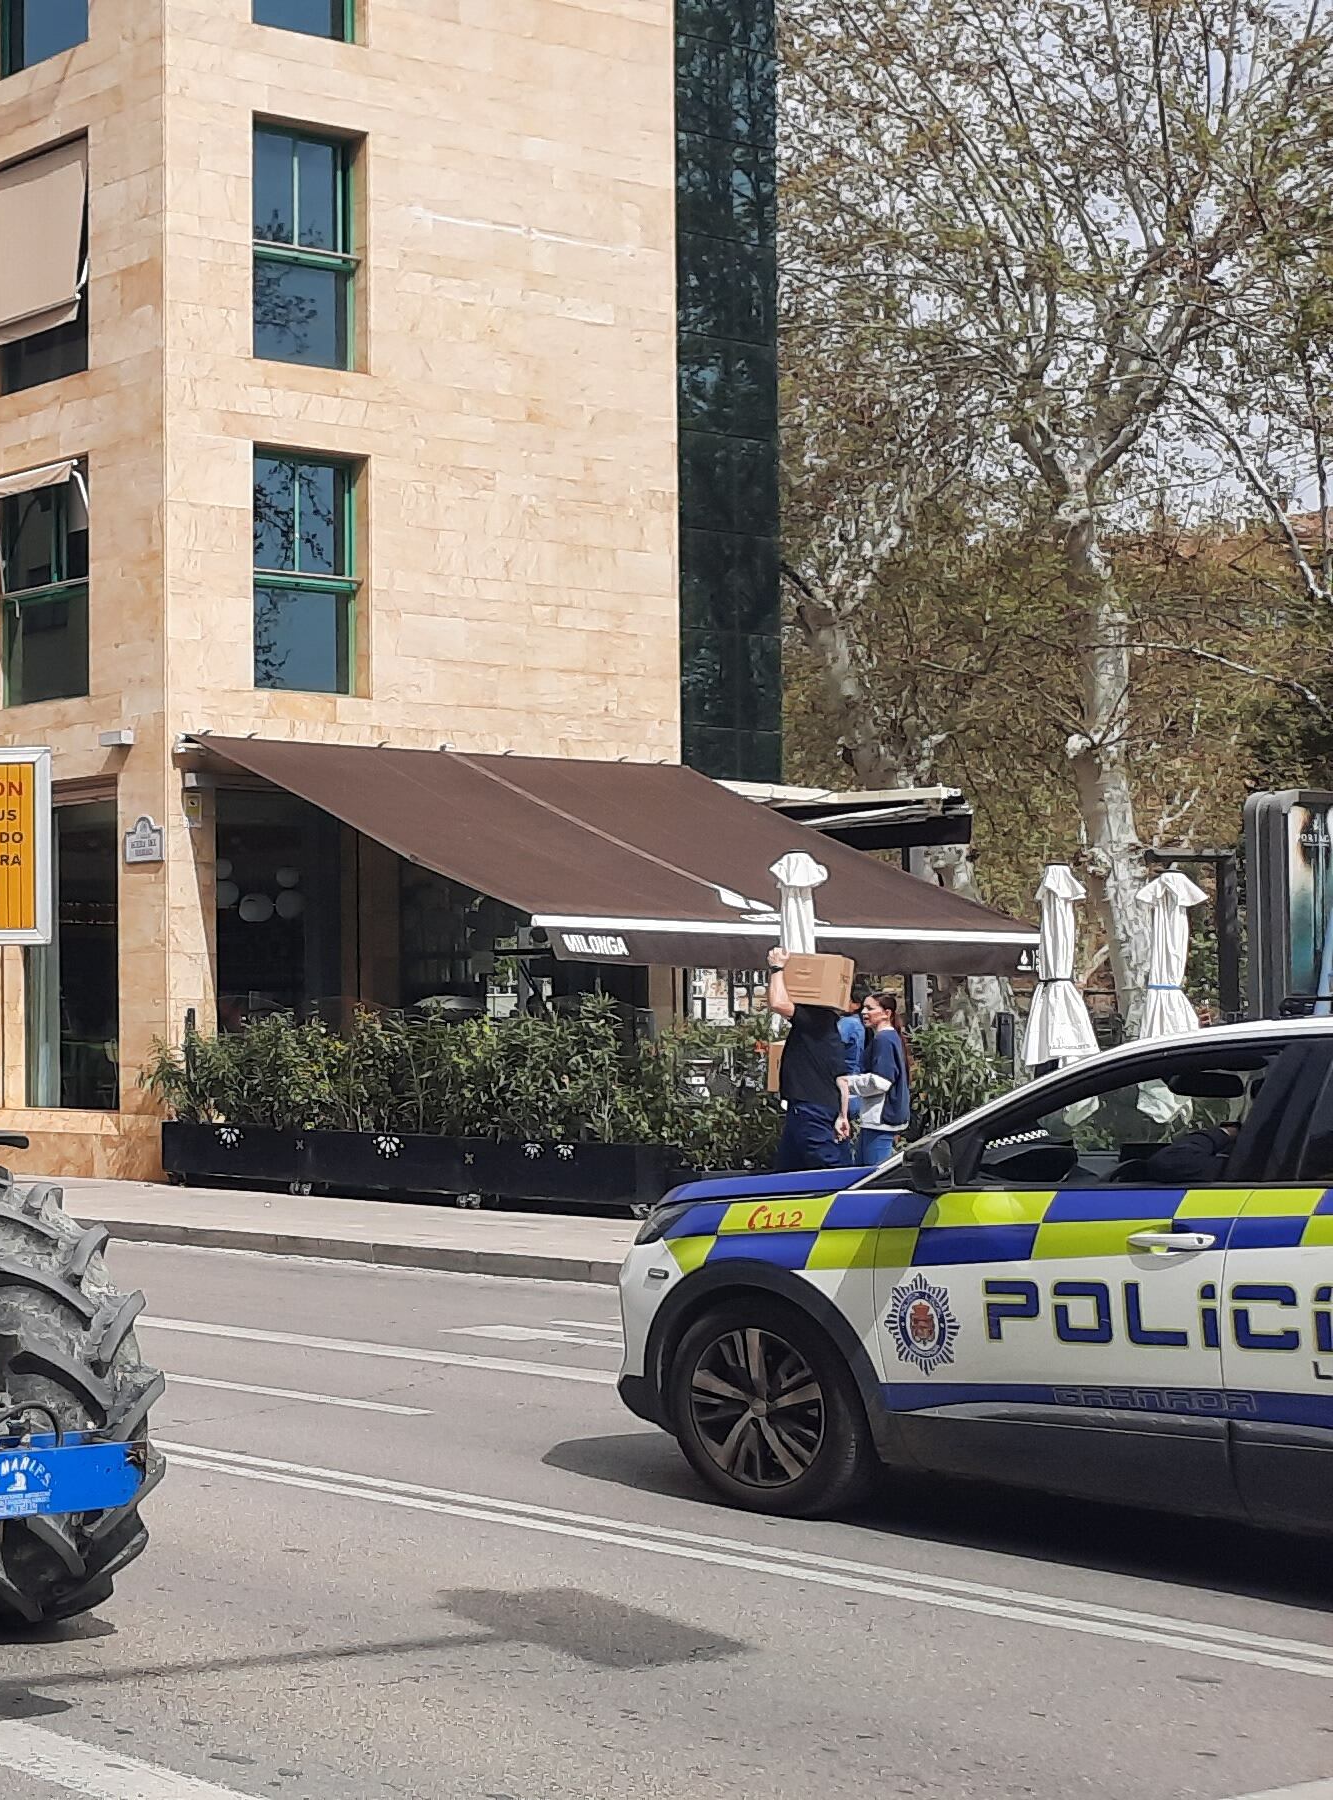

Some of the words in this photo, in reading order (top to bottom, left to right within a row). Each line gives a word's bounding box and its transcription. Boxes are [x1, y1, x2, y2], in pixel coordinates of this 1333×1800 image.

[561, 933, 630, 956] MILONGA
[762, 1210, 803, 1229] 112
[1052, 1386, 1257, 1413] GRANADA
